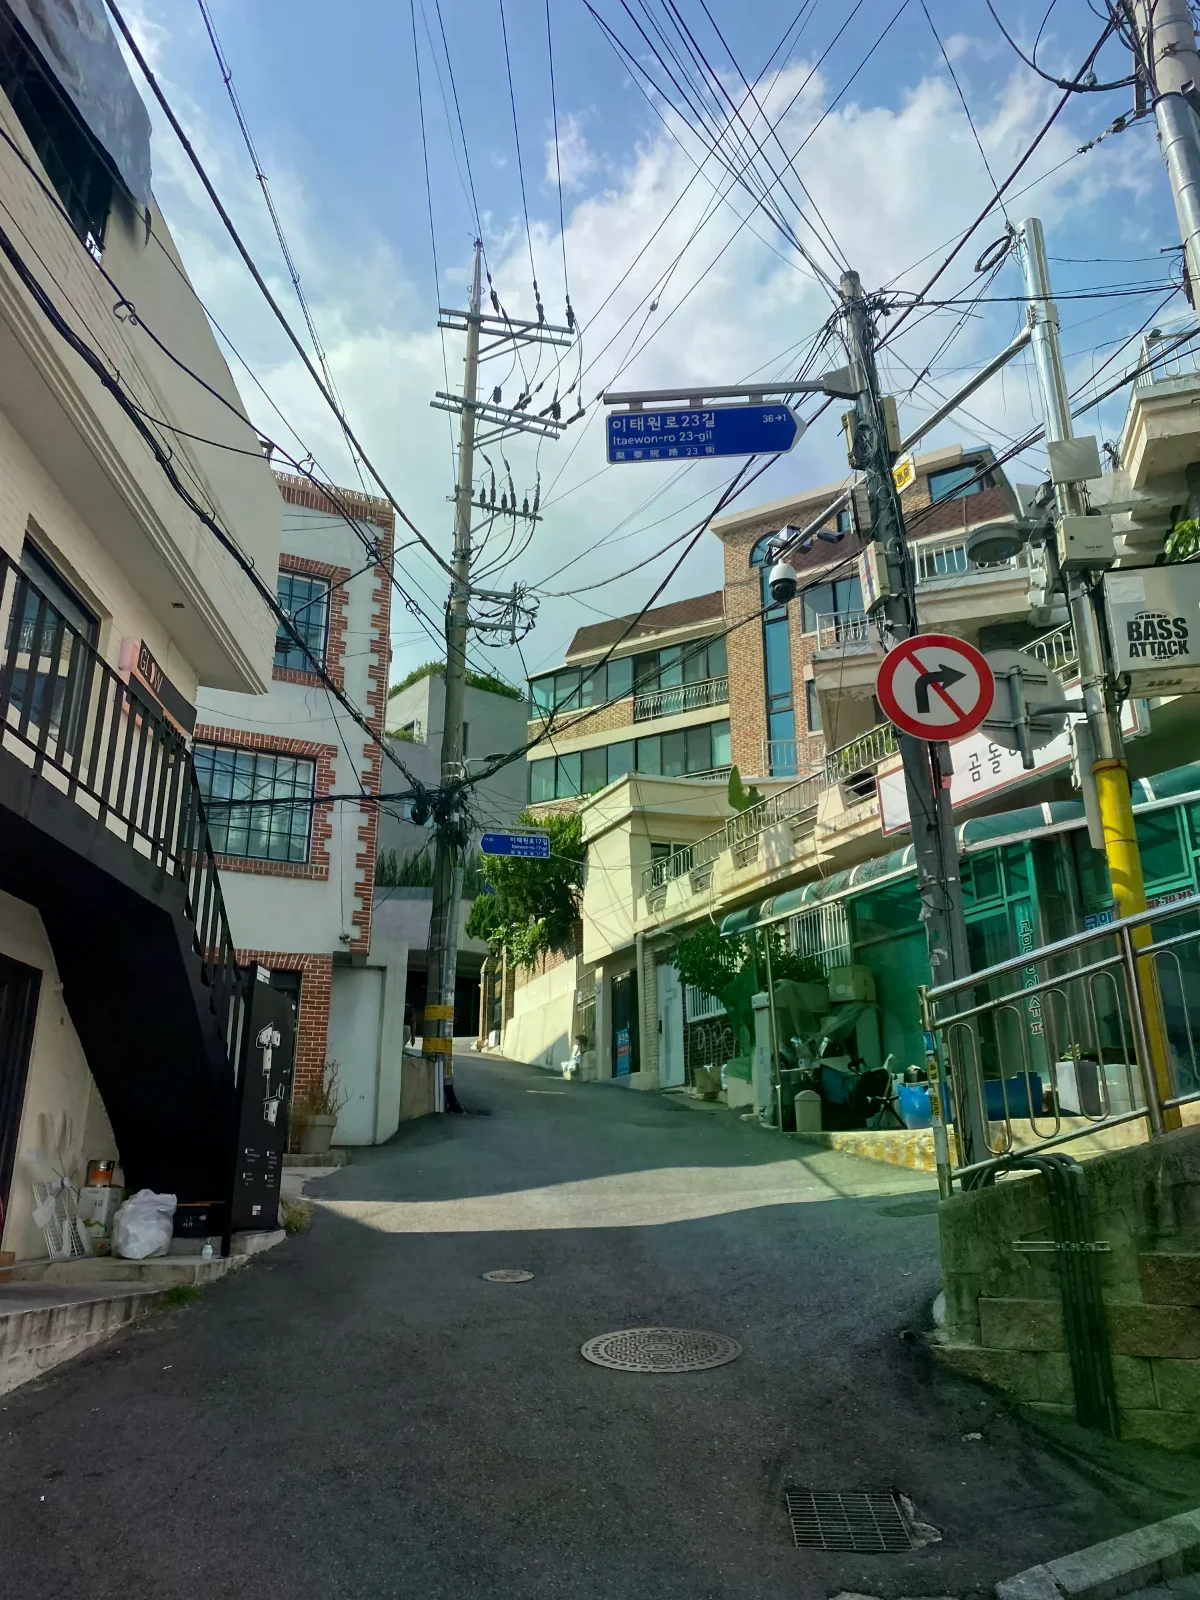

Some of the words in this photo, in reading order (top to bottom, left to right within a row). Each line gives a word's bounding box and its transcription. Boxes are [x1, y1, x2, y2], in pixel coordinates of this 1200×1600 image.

[612, 412, 716, 433] 이태원로23길
[762, 414, 774, 424] 36
[613, 434, 676, 446] Itaewon-ro
[679, 430, 713, 443] 23-gil
[1126, 617, 1189, 642] BASS
[1128, 639, 1190, 658] ATTACK
